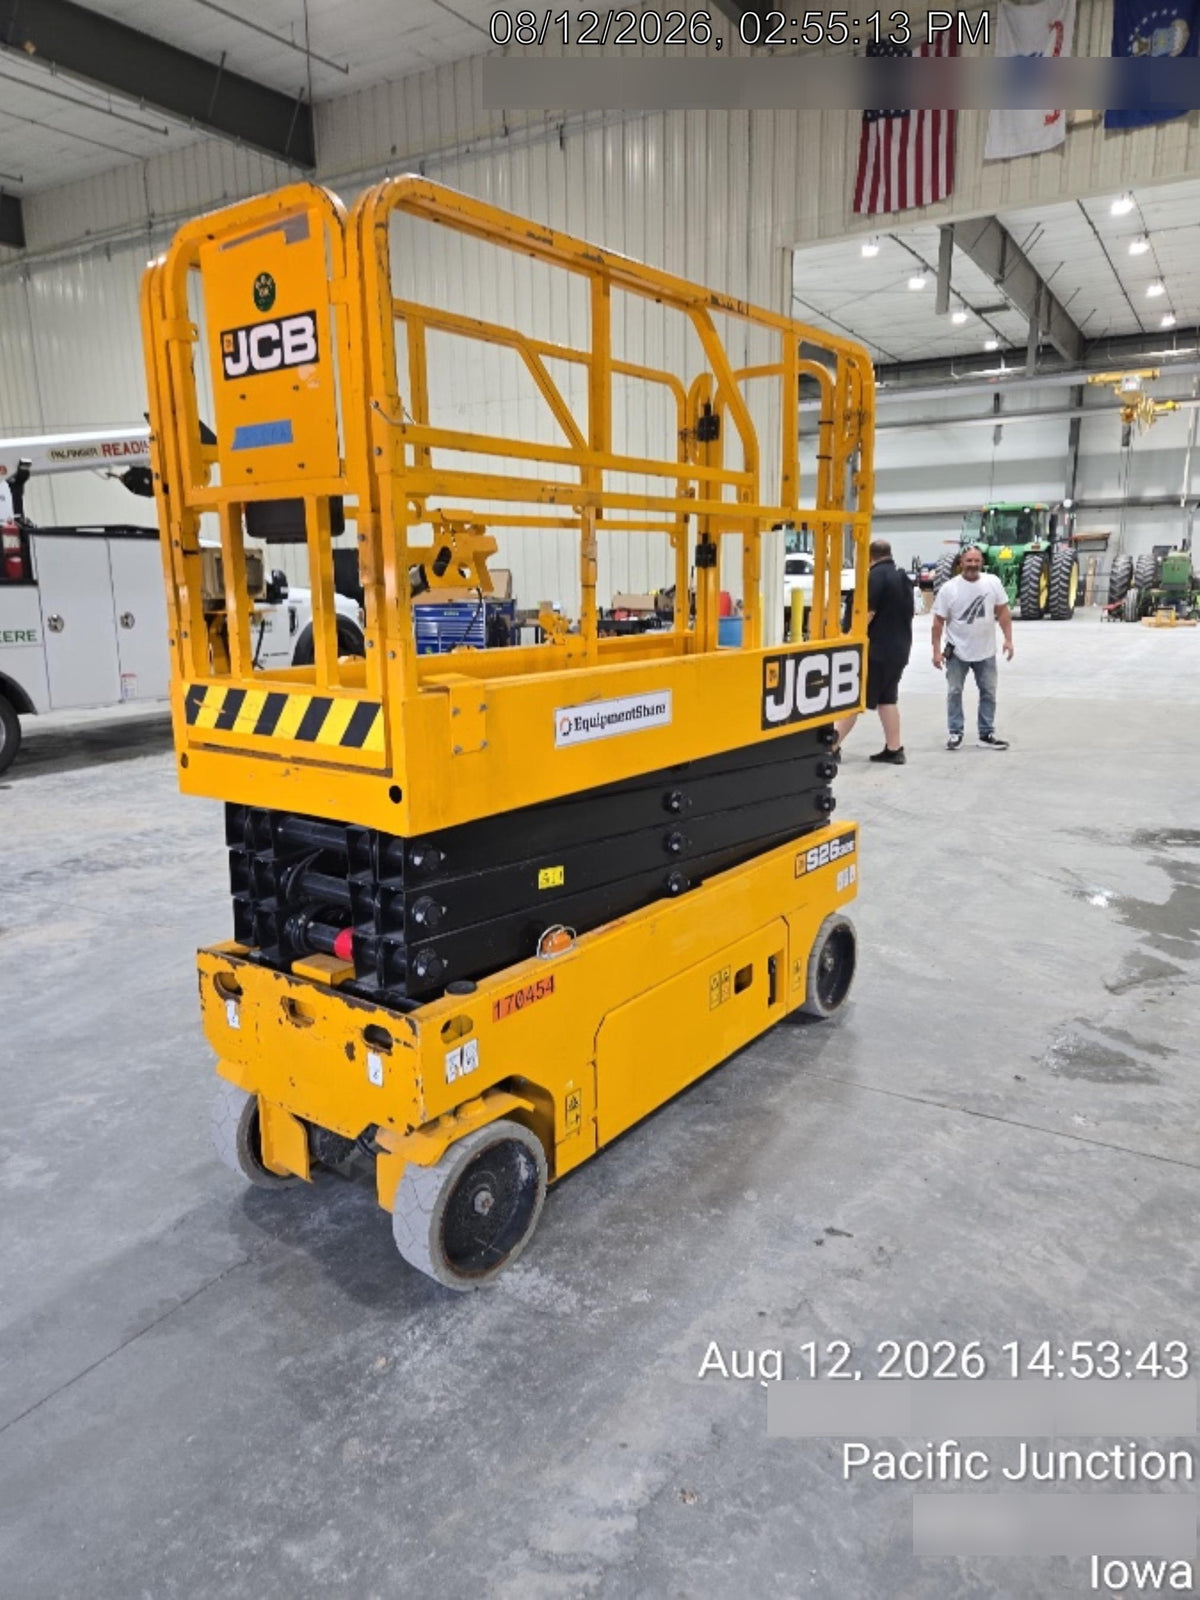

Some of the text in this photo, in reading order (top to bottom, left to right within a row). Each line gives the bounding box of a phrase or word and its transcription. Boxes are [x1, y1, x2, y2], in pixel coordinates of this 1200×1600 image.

[224, 315, 317, 376] JCB
[765, 650, 860, 723] JCB
[494, 975, 554, 1020] 170454
